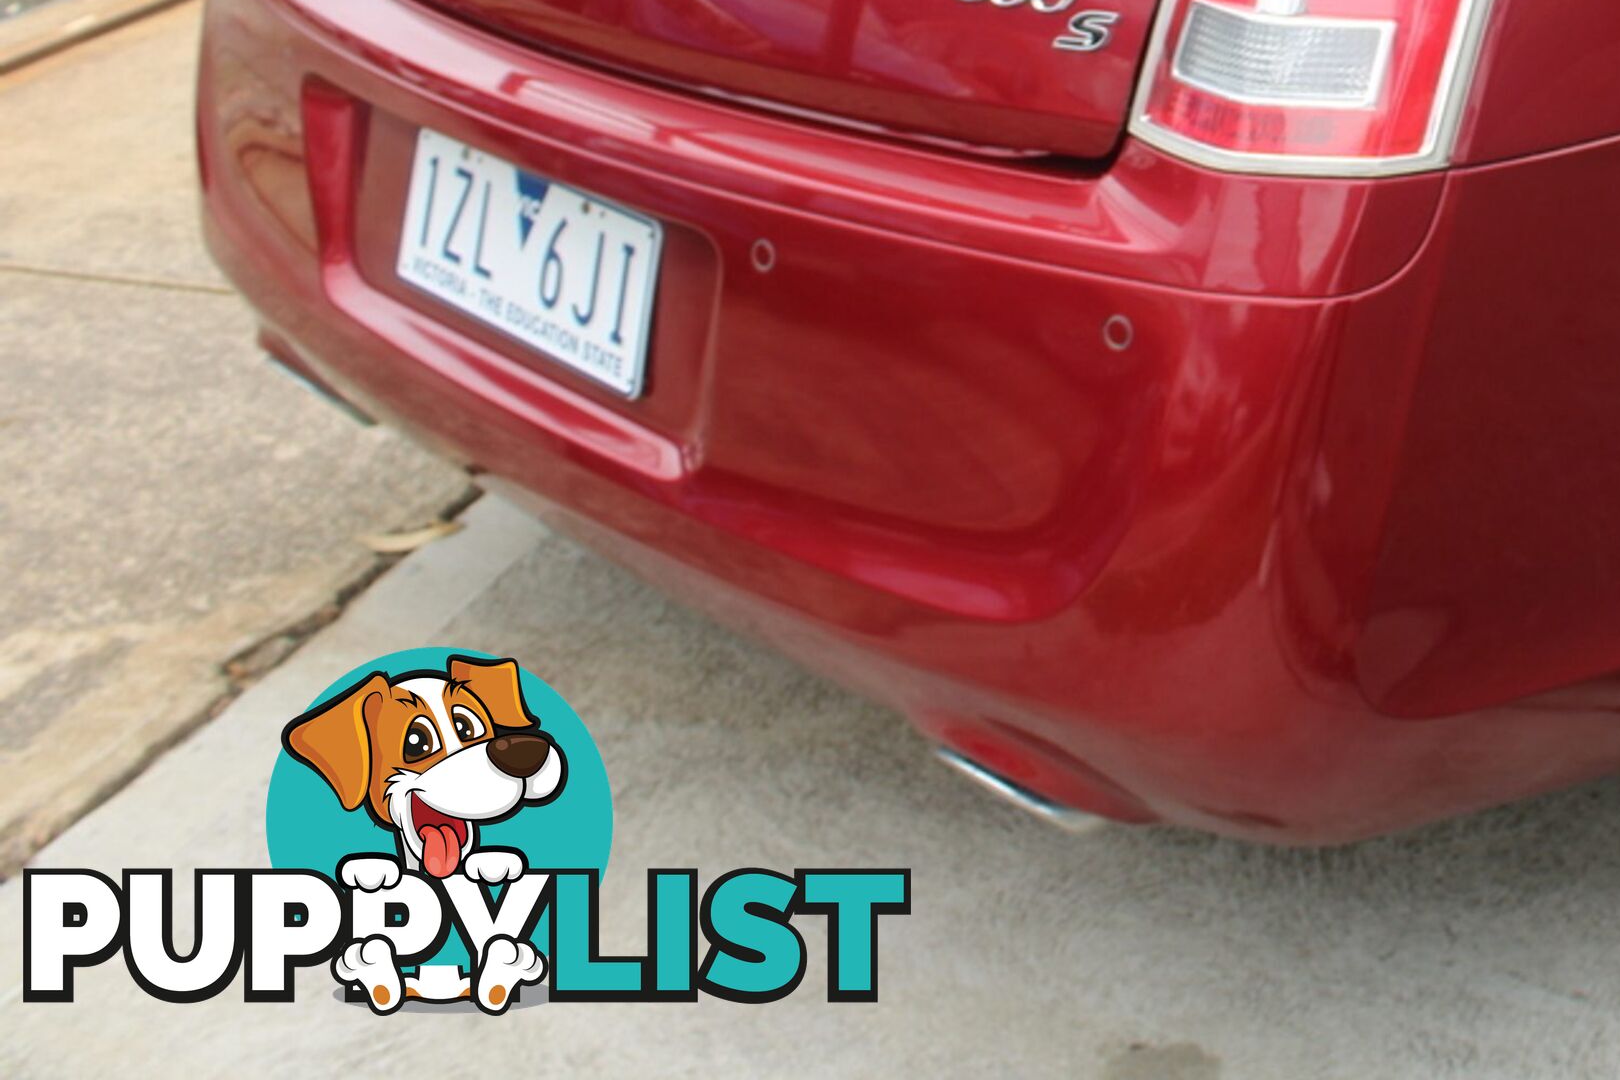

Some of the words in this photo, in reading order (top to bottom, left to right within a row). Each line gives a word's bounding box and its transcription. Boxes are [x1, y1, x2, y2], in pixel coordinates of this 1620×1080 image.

[1052, 9, 1120, 51] S
[413, 256, 467, 298] VICTORIA
[479, 288, 503, 318] THE
[506, 301, 579, 351] EDUCATION
[583, 340, 623, 378] STATE
